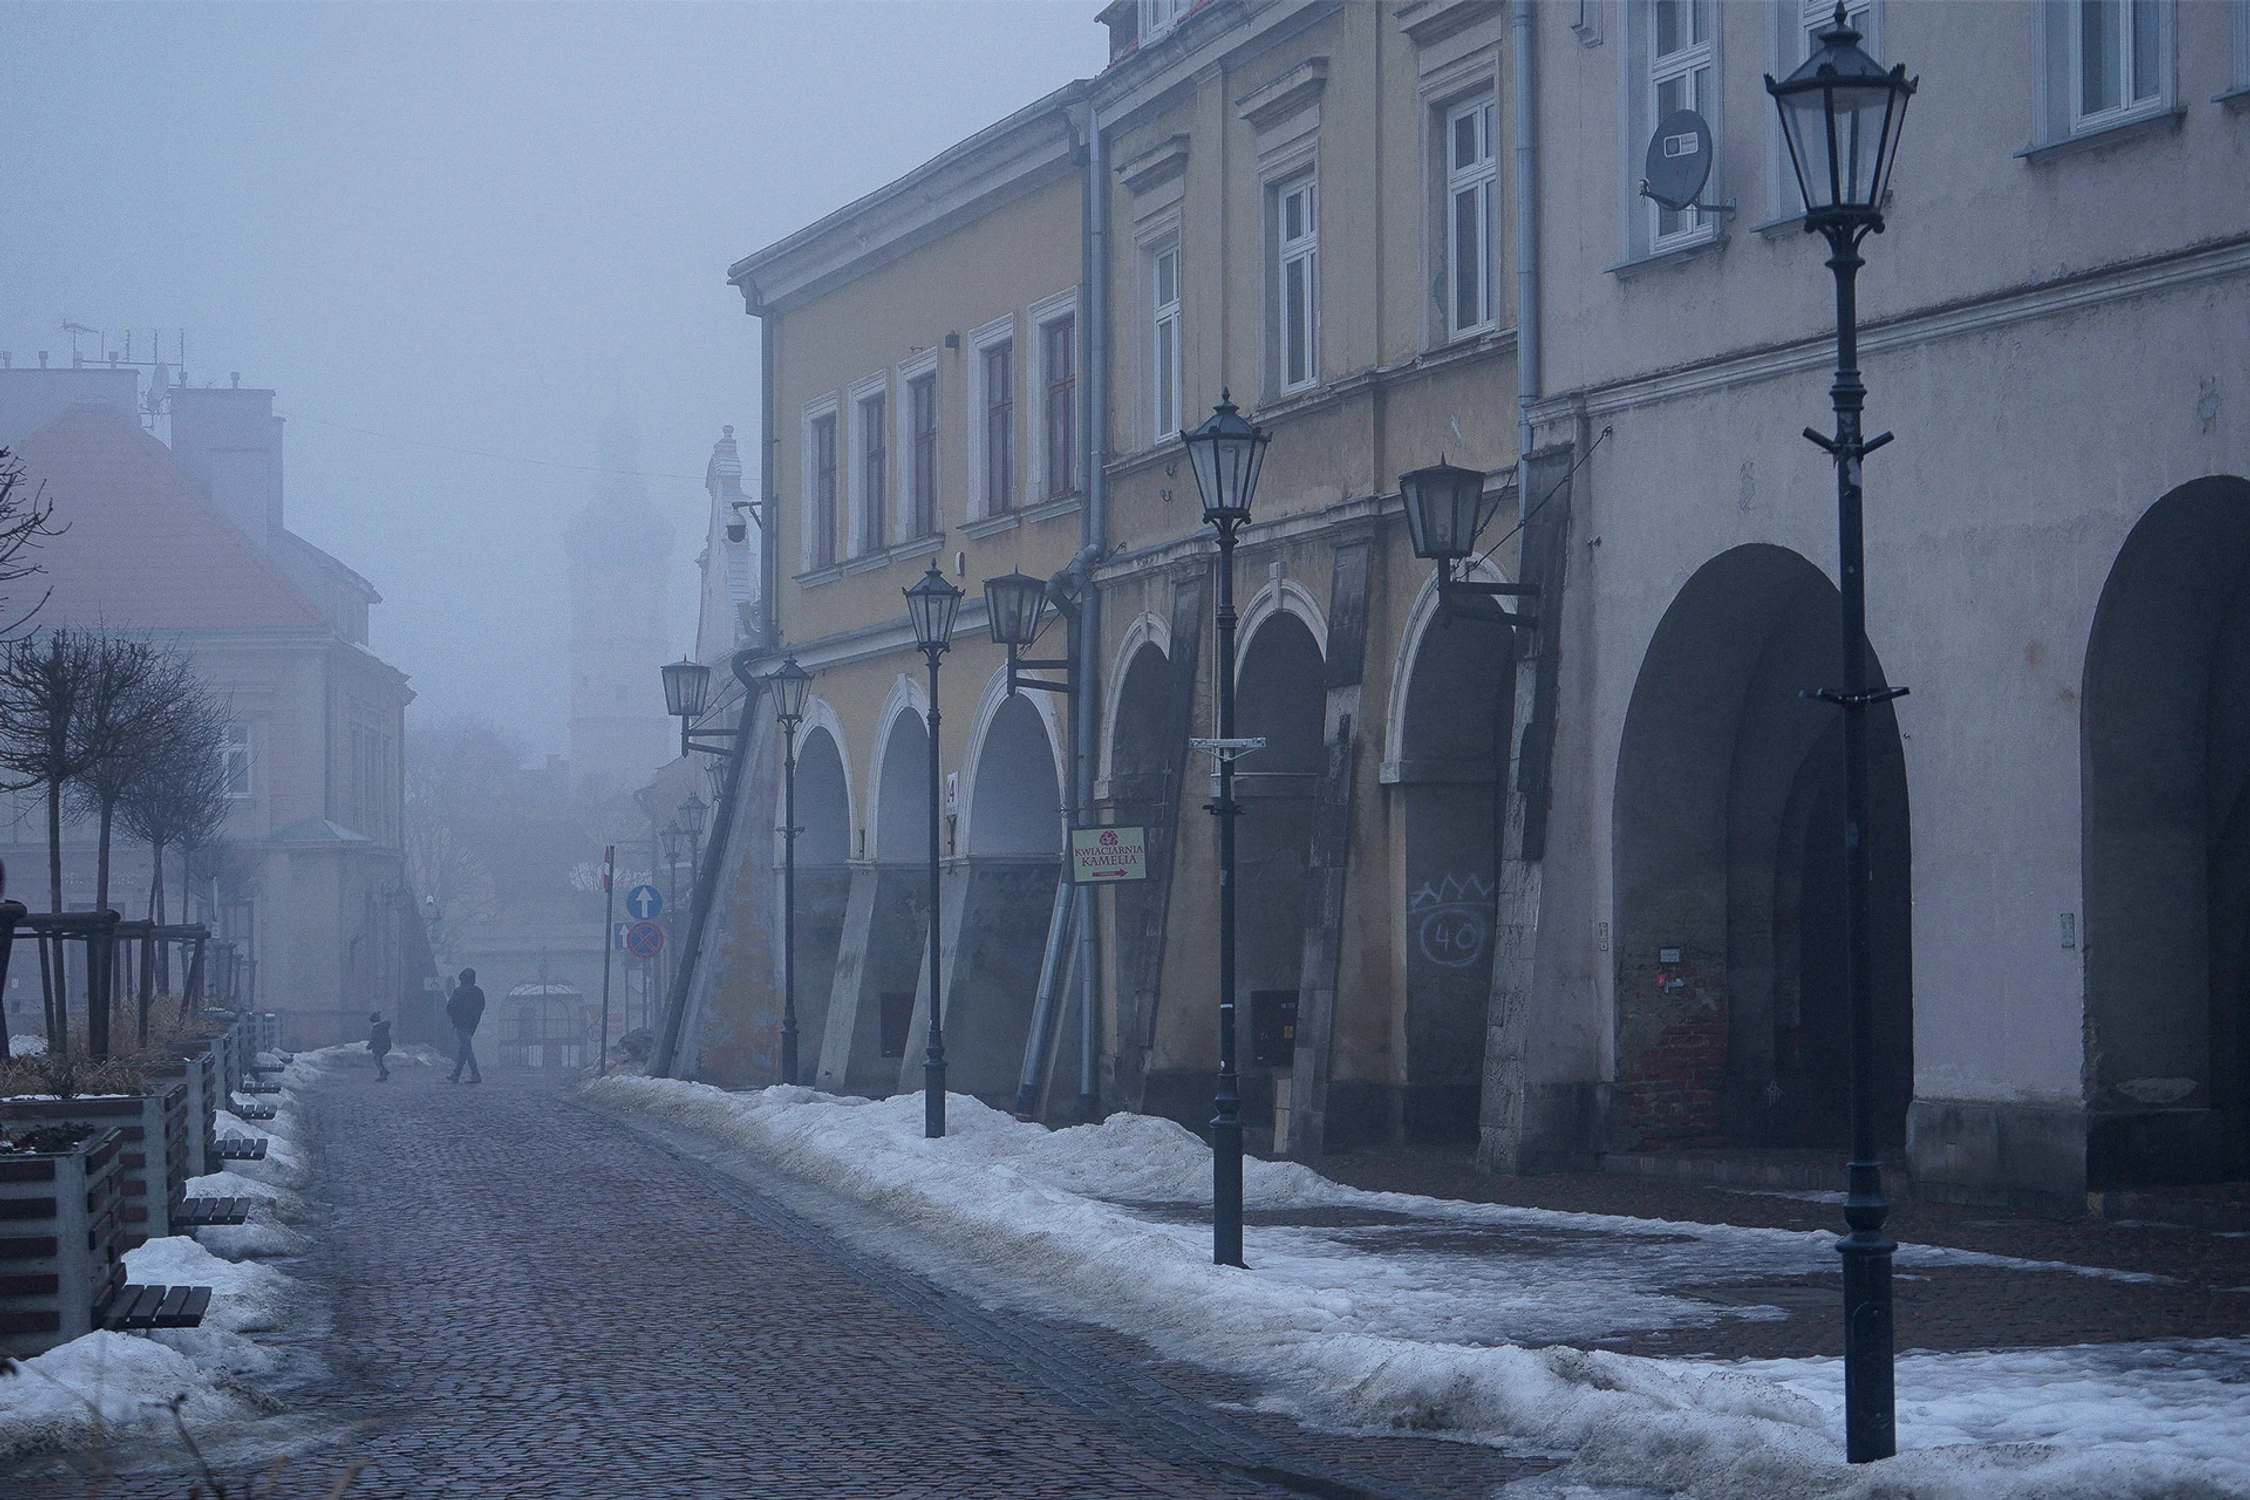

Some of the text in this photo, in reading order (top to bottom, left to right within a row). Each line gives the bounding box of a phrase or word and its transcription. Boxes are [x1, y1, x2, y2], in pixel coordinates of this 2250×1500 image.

[1074, 845, 1144, 857] KWIACIARNIA
[1082, 855, 1137, 867] KAMELIA
[1435, 922, 1478, 952] 40
